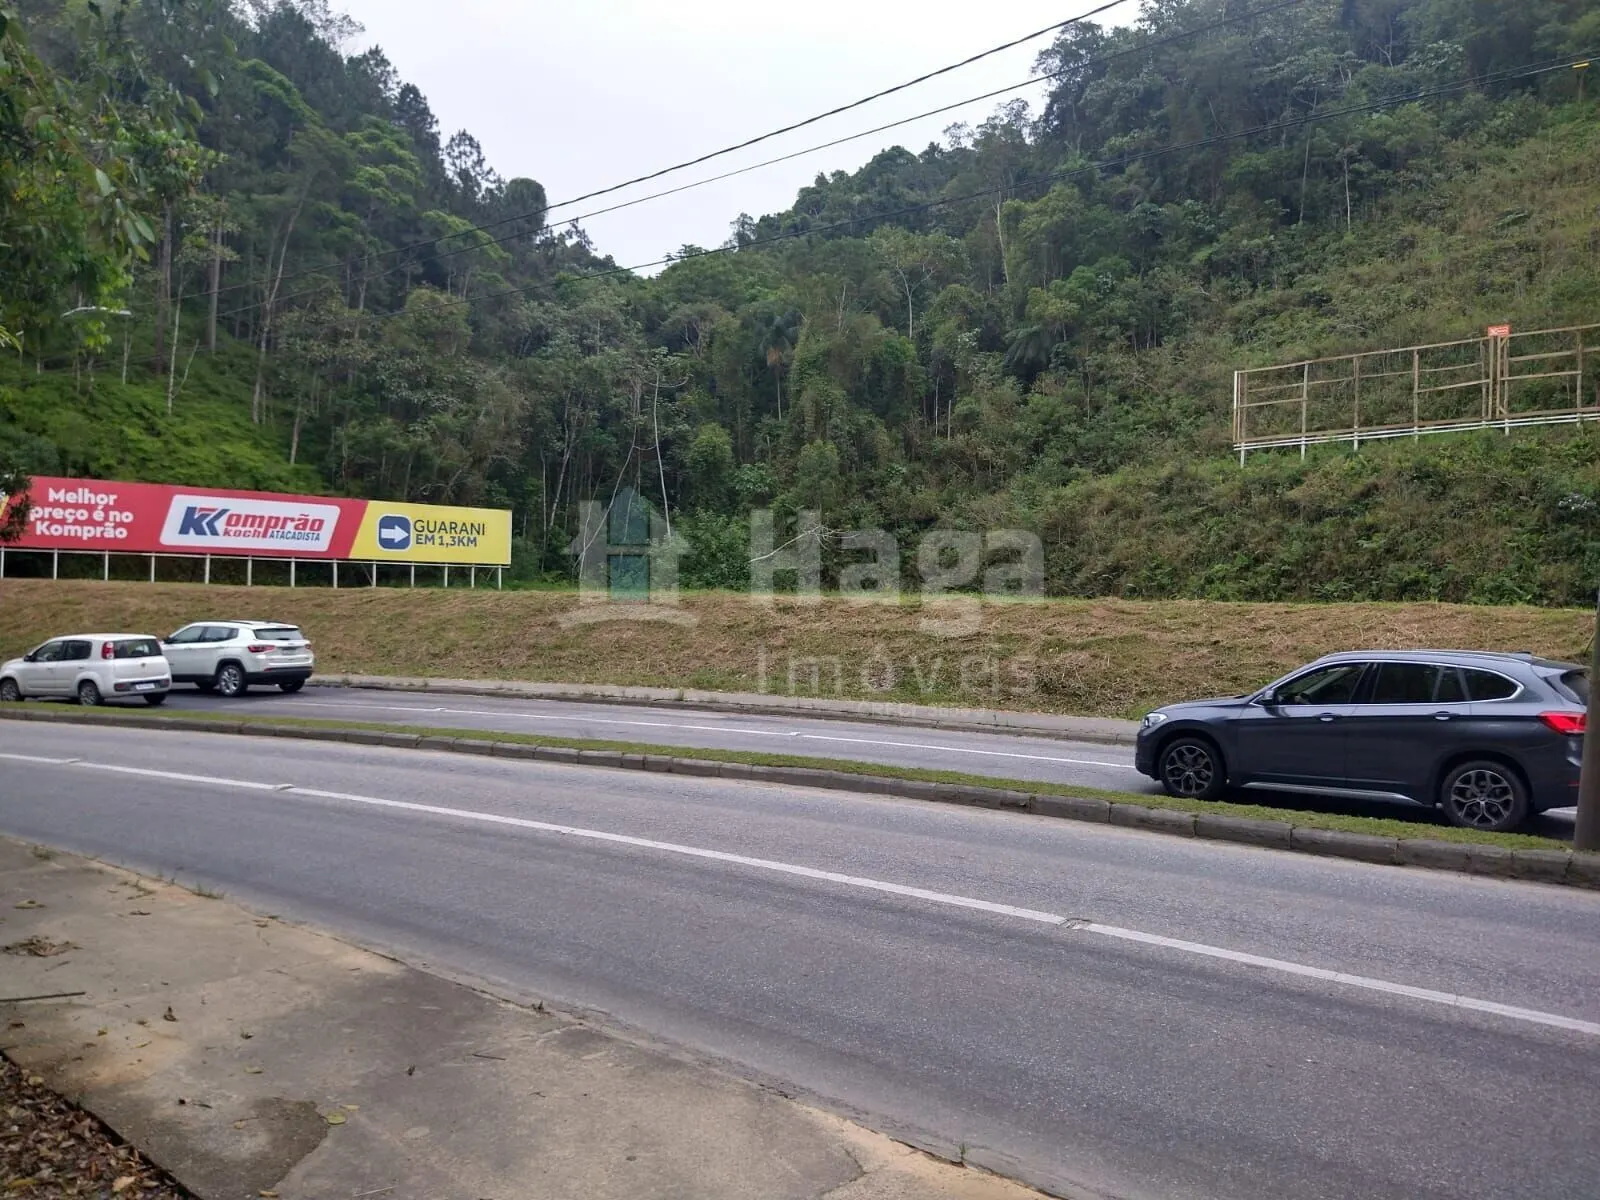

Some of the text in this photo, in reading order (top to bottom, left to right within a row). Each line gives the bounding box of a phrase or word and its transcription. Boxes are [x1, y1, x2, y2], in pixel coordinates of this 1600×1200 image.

[48, 487, 118, 506] Melhor
[30, 504, 134, 523] preço é no
[35, 520, 128, 540] Komprão
[222, 527, 321, 542] koch ATACADISTA
[413, 519, 486, 536] GUARANI
[415, 533, 478, 548] EM 1,3KM
